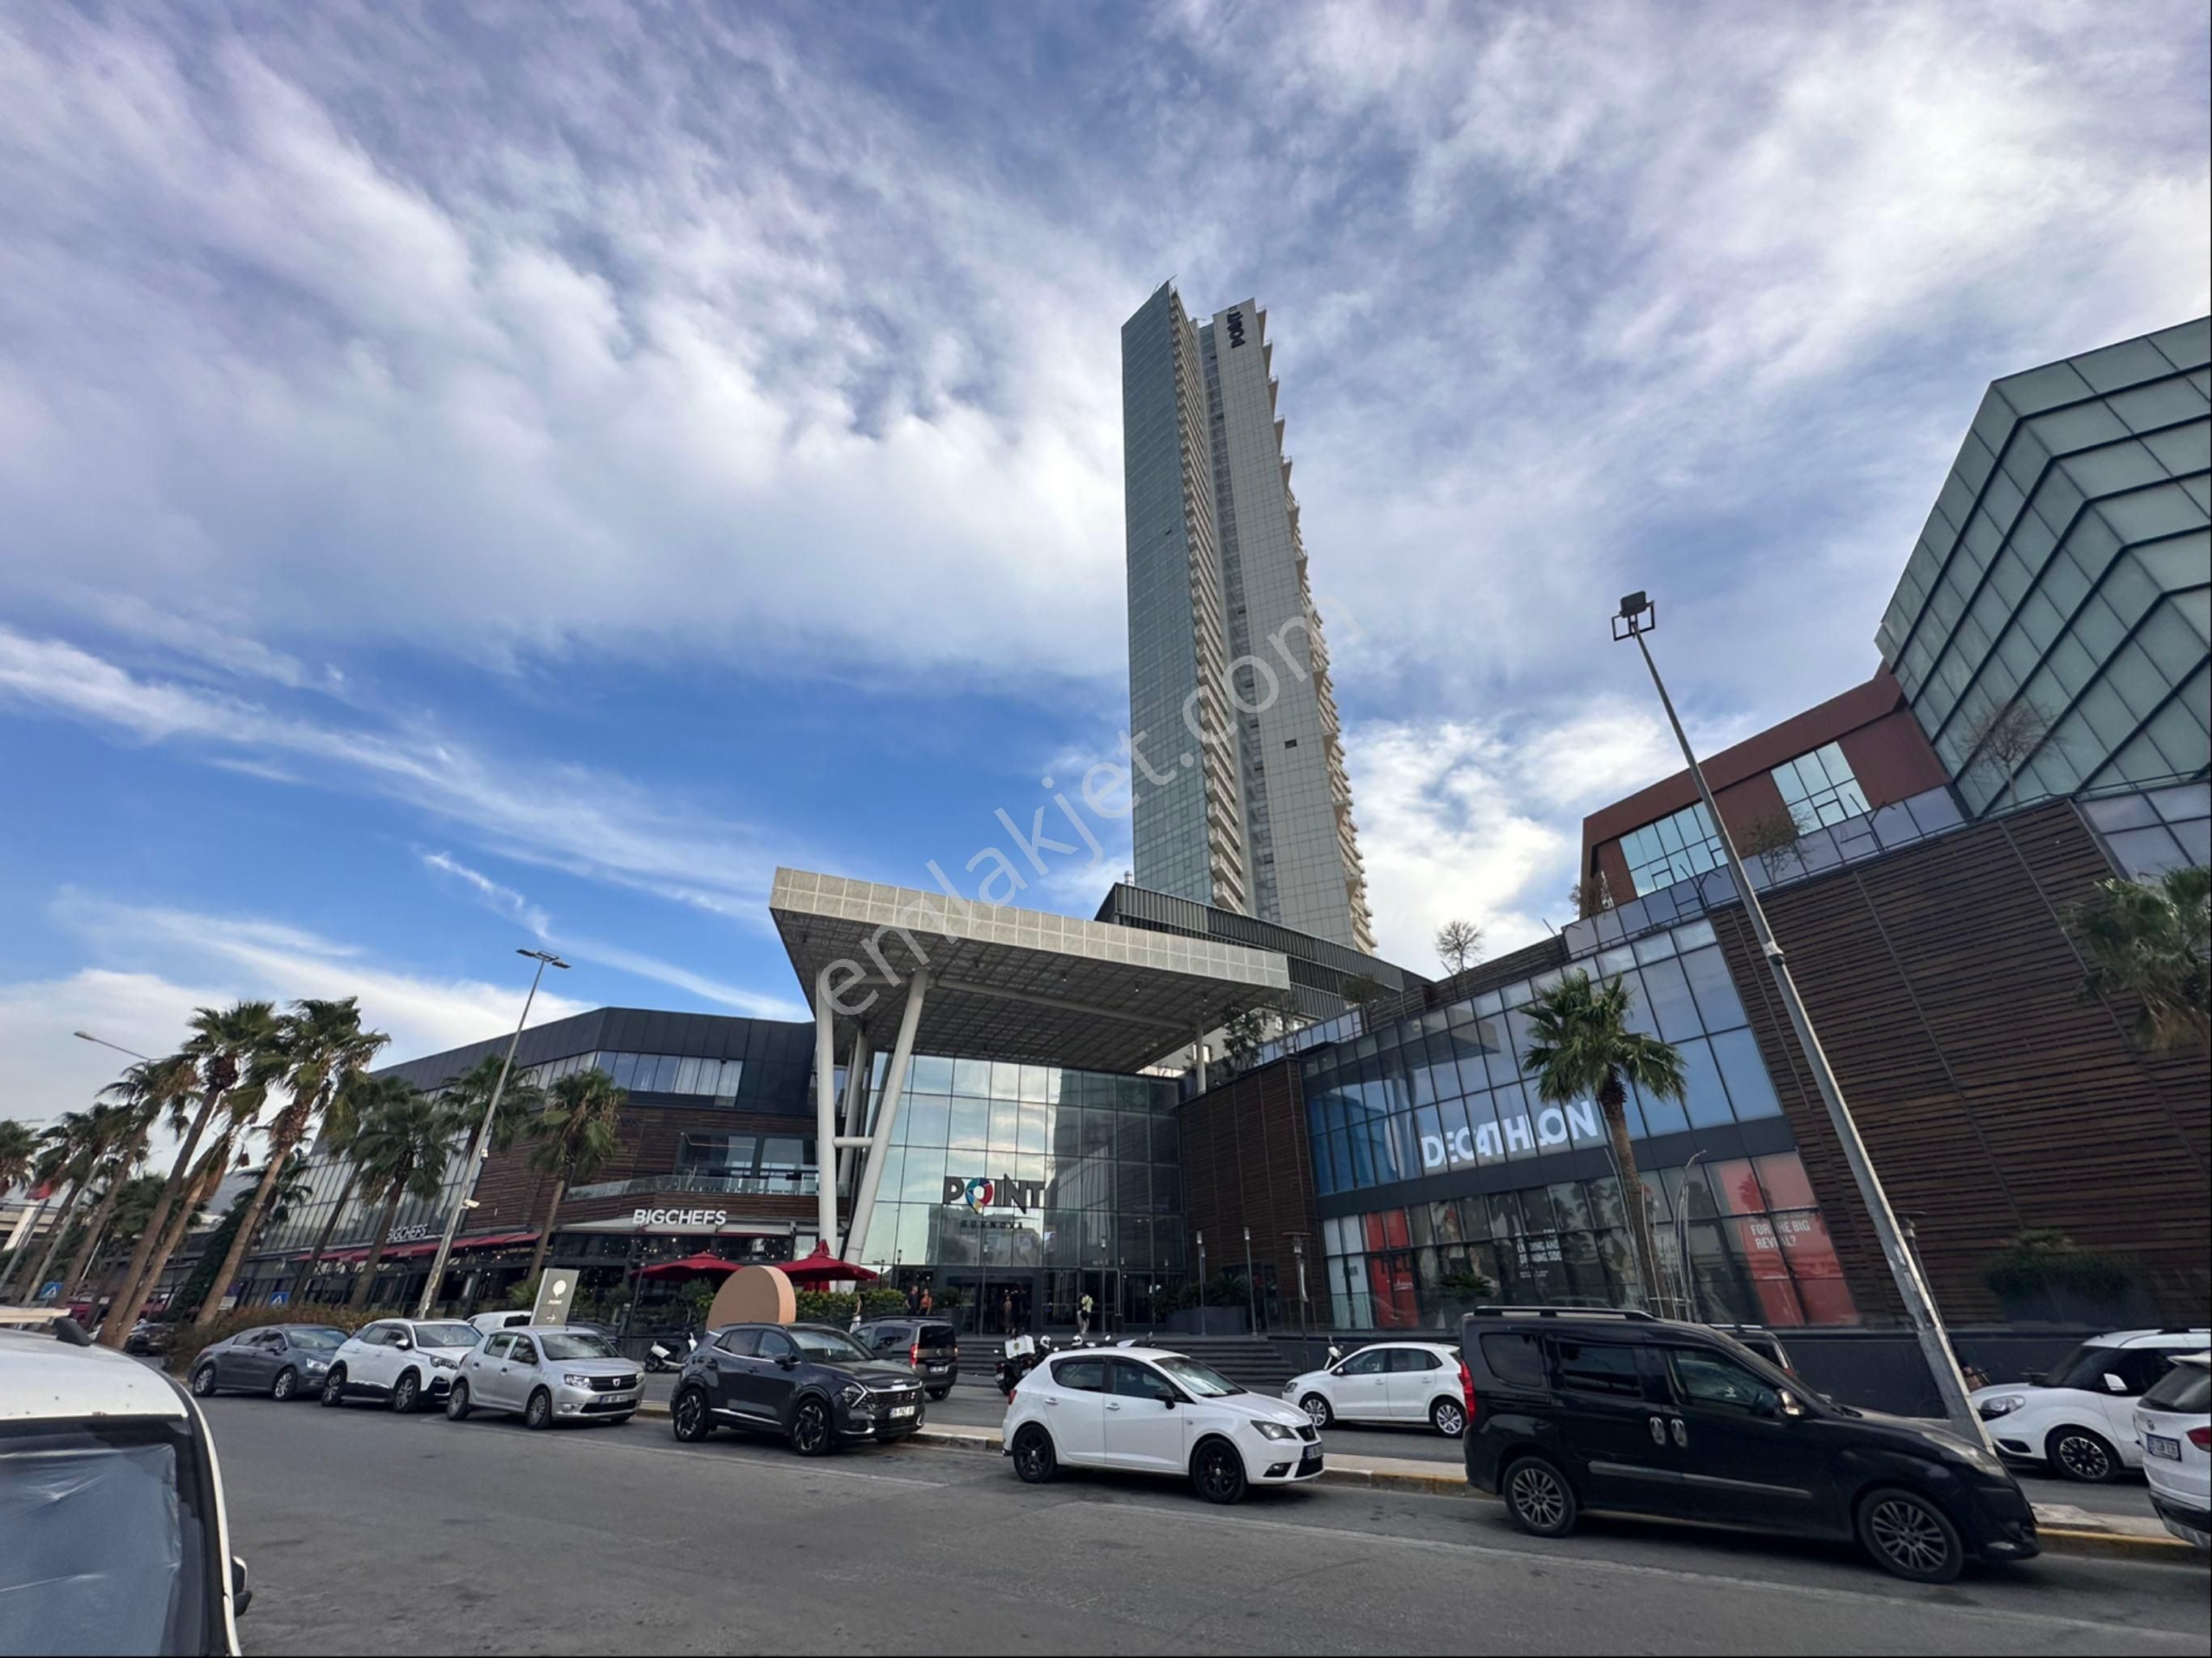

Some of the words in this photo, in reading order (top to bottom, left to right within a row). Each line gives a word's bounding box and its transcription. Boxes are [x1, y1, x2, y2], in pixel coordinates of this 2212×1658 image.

[1420, 1100, 1598, 1168] DECATHLON
[942, 1173, 1046, 1215] POINT
[632, 1209, 727, 1225] BIGCHEFS
[1750, 1223, 1771, 1236] FOR
[1791, 1219, 1811, 1232] BIG
